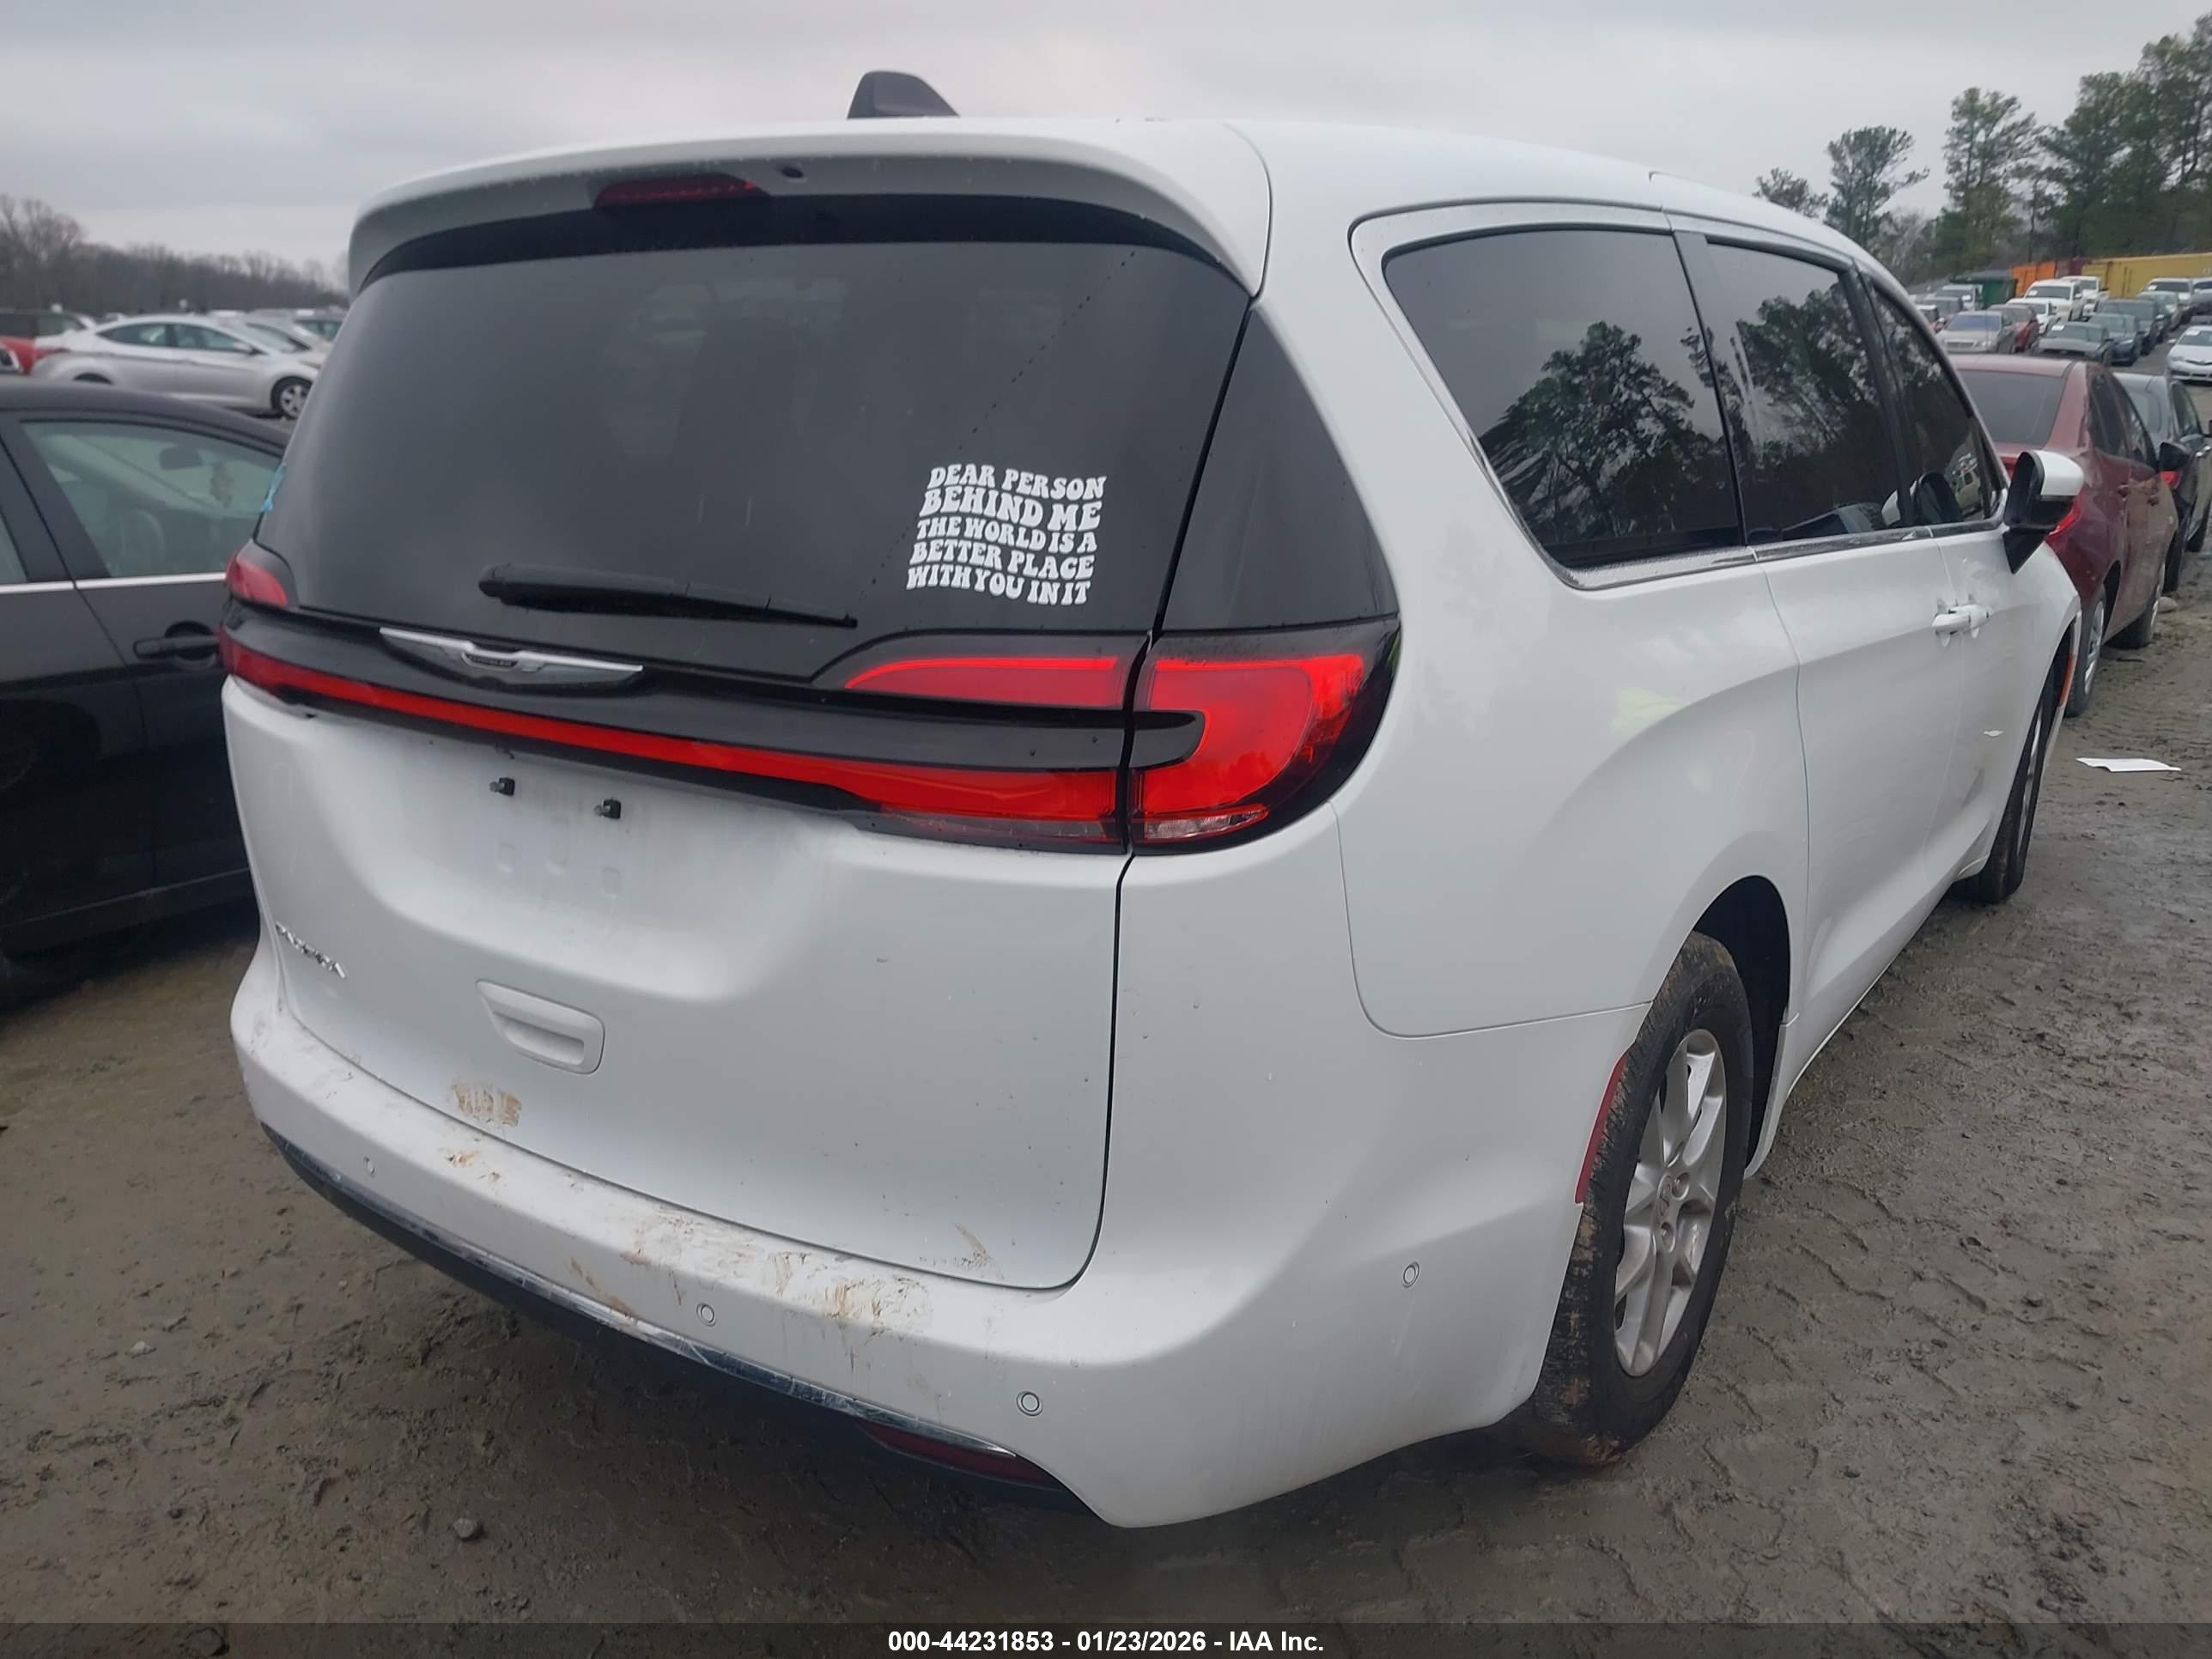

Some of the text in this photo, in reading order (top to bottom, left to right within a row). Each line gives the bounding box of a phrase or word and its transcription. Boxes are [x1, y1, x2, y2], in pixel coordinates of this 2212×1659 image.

[927, 464, 1107, 501] DEAR PERSON
[919, 486, 1103, 532] BEHIND ME
[916, 516, 1097, 553] THE WORLD IS A
[909, 538, 1095, 580] BETTER PLACE
[906, 564, 1091, 605] WITH YOU IN IT
